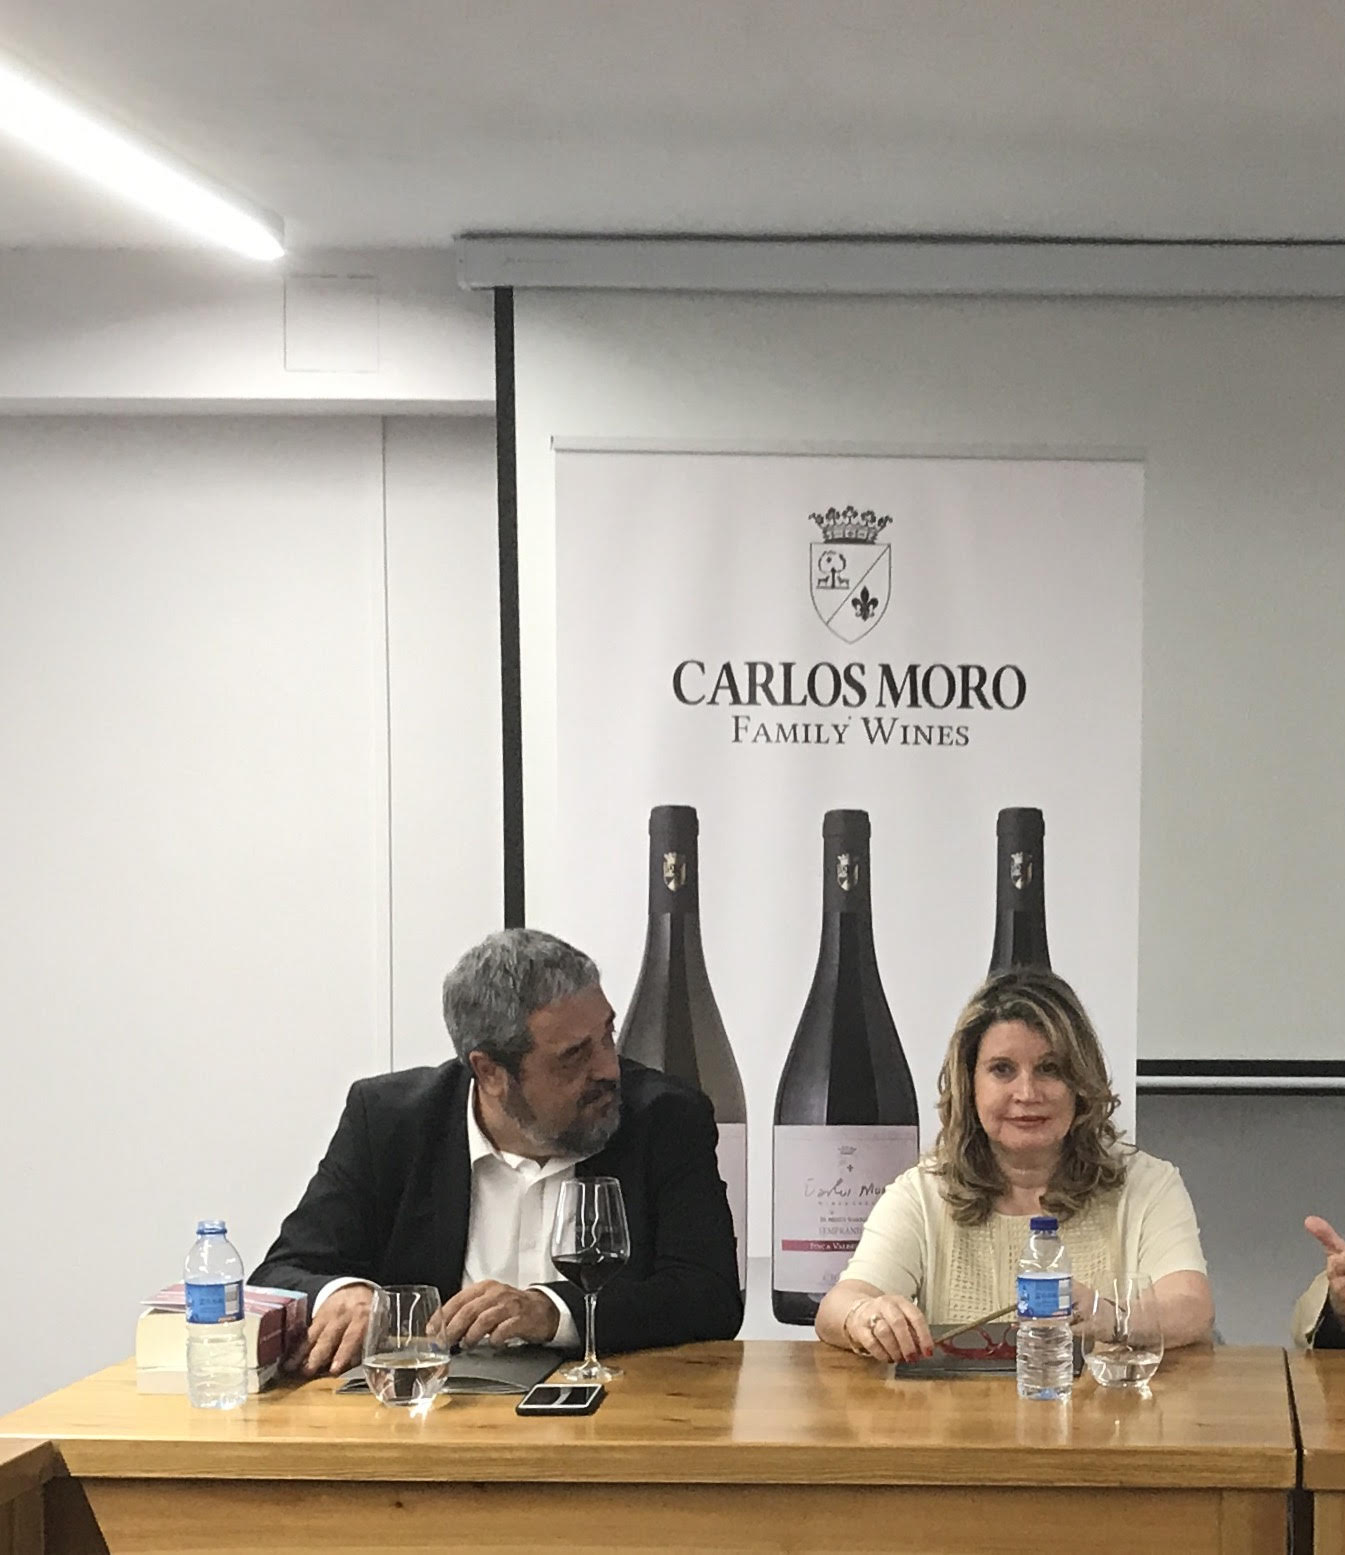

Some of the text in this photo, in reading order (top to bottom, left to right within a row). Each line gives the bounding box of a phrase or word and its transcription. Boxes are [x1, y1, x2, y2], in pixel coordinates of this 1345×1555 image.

[672, 659, 1027, 710] CARLOS MORO
[731, 715, 970, 747] FAMILY WINES
